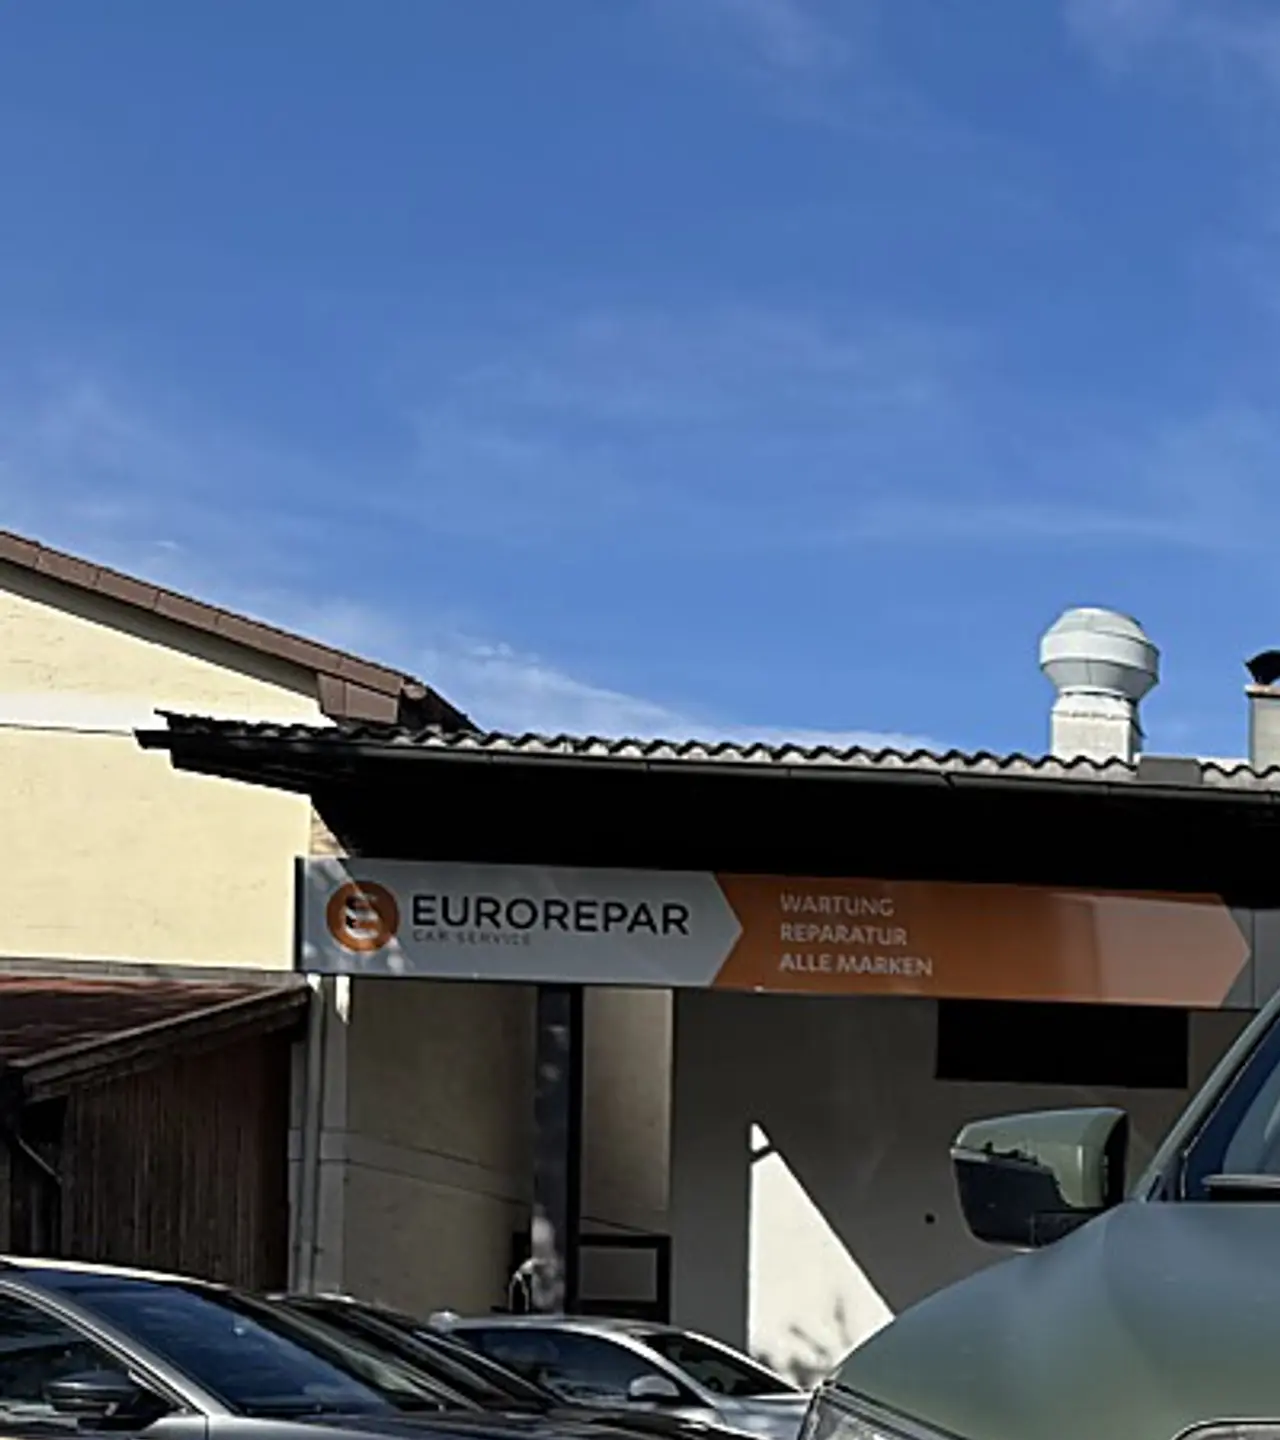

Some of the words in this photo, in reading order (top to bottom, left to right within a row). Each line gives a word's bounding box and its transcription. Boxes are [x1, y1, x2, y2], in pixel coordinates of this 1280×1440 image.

[412, 894, 690, 936] EUROREPAR
[780, 892, 895, 917] WARTUNG
[780, 922, 907, 946] REPARATUR
[779, 952, 832, 972] ALLE
[836, 955, 933, 977] MARKEN
